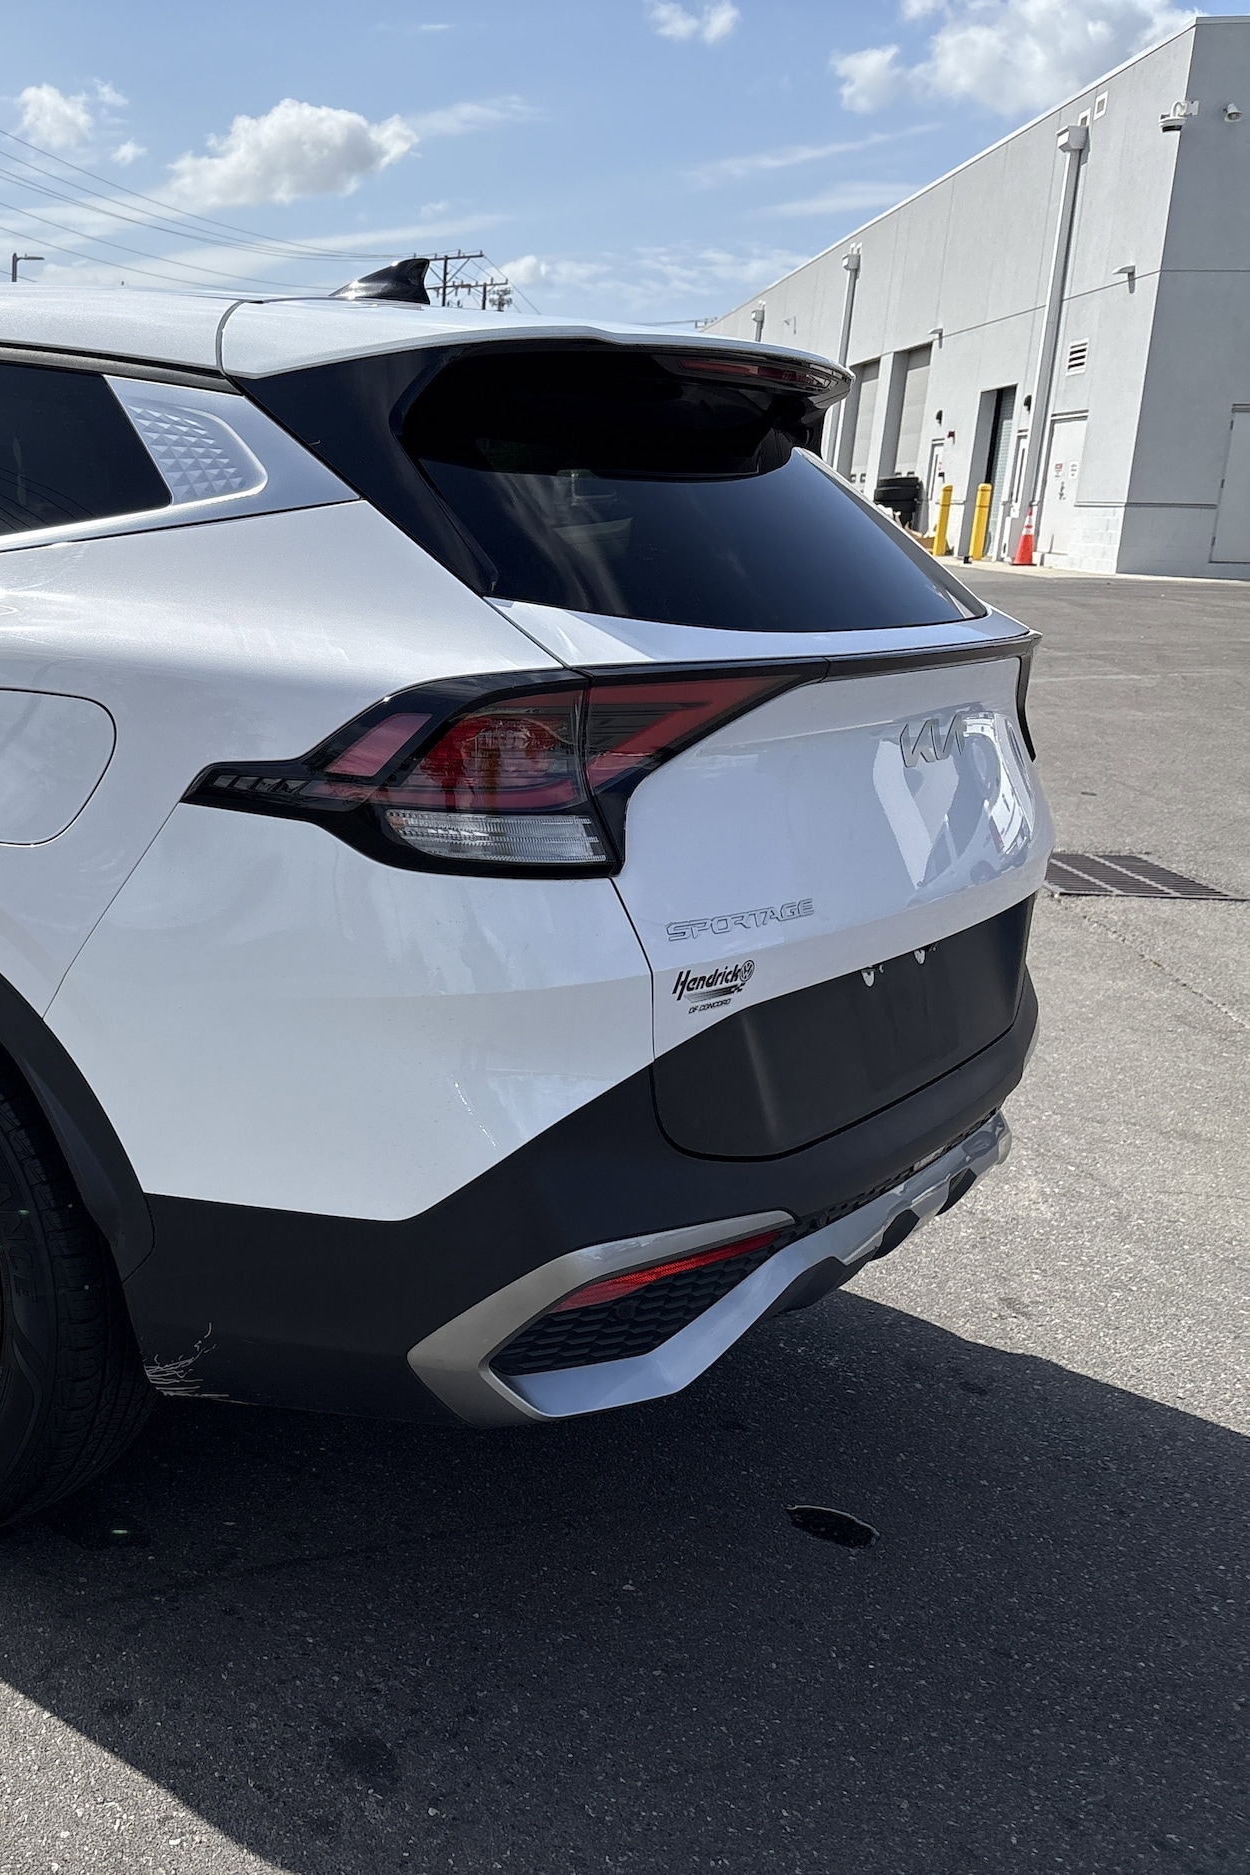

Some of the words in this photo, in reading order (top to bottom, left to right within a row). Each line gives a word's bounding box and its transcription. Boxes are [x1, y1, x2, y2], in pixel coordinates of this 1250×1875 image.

[665, 898, 815, 942] SPORTAGE
[671, 964, 742, 1001] Hendrick
[688, 1005, 699, 1014] OF
[698, 998, 732, 1012] CONCORD
